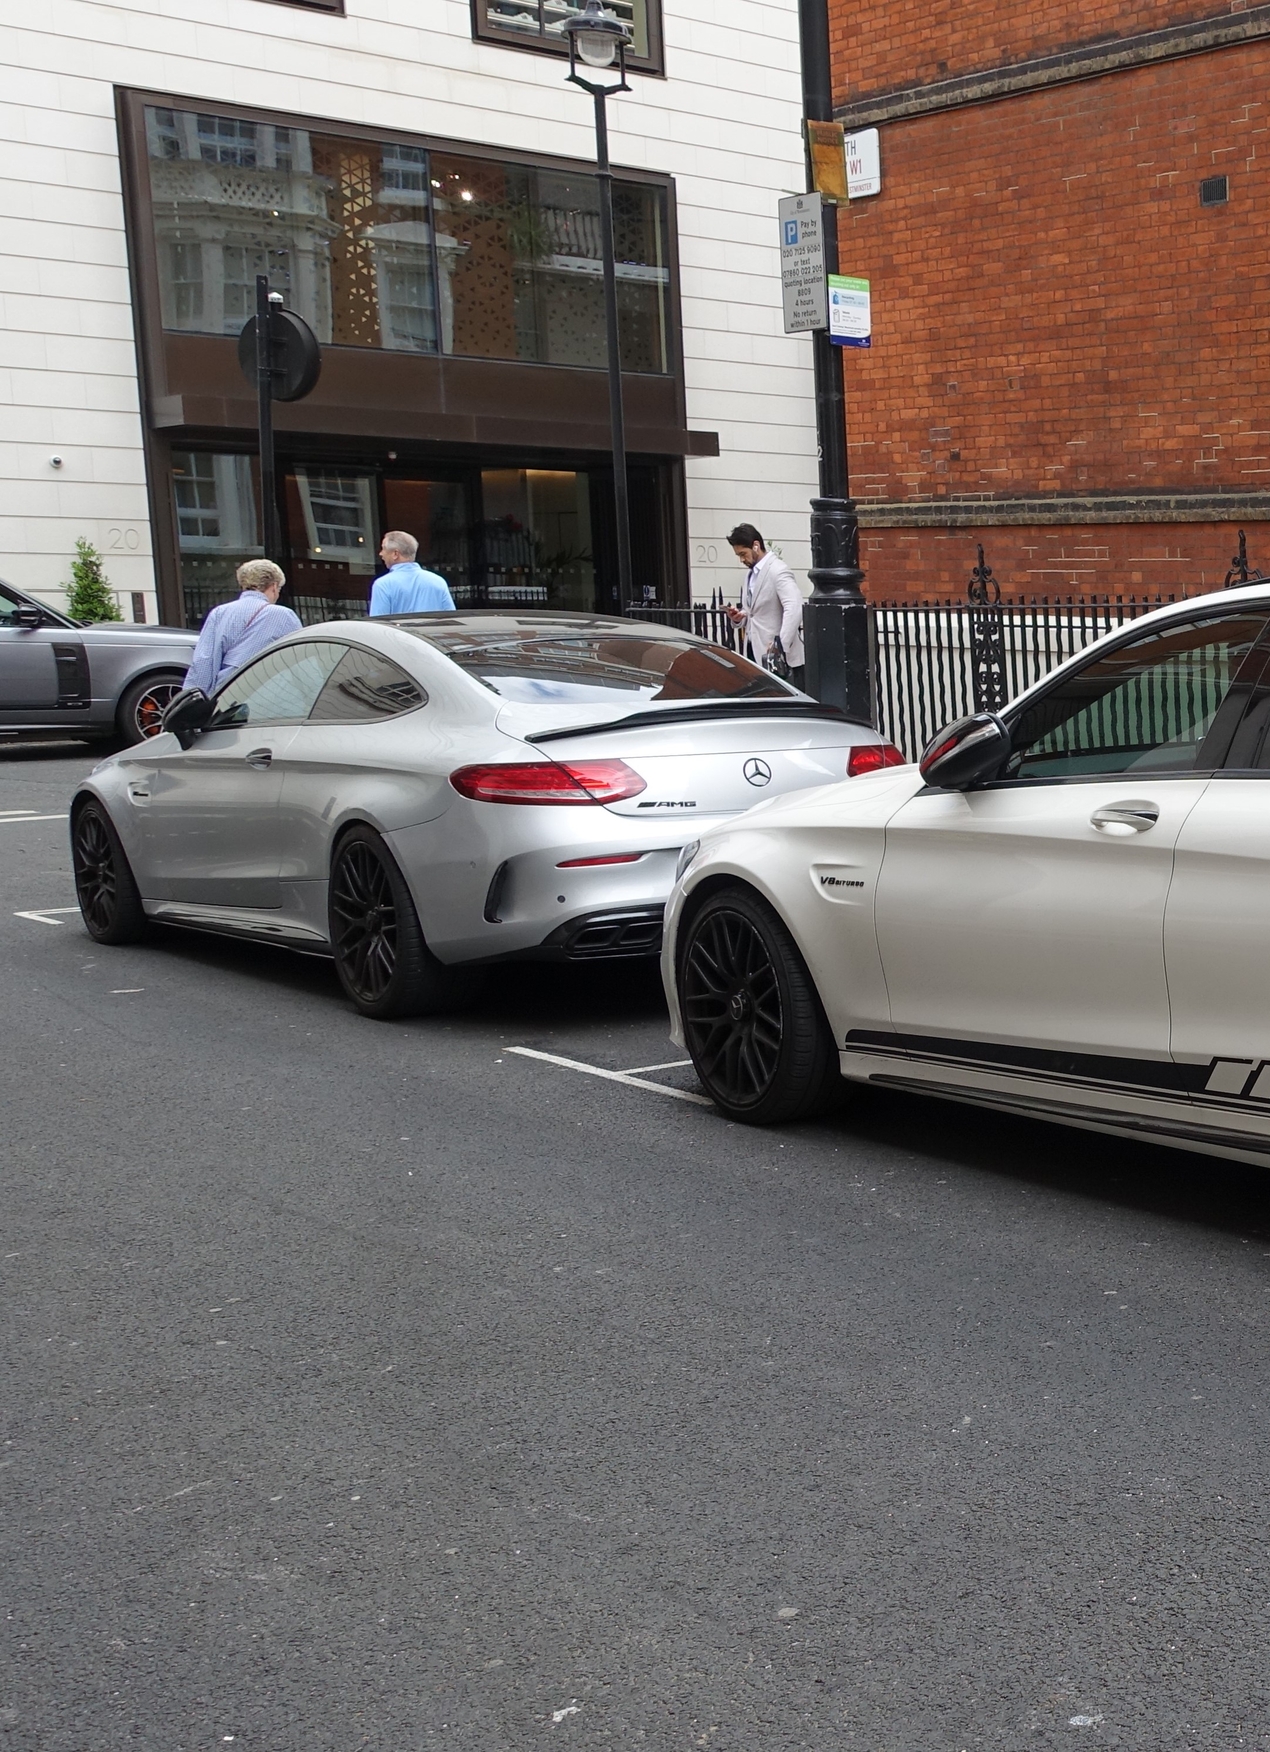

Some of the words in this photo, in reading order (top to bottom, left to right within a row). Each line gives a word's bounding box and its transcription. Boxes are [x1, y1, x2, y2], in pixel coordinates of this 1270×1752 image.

[844, 139, 857, 156] TH
[850, 159, 861, 175] W1
[849, 183, 872, 193] STMINSTER
[801, 220, 809, 229] Pay
[811, 219, 817, 228] by
[802, 230, 817, 239] phone
[801, 257, 811, 266] text
[784, 280, 802, 289] quoting
[803, 276, 823, 284] location
[801, 309, 817, 317] return
[790, 319, 805, 328] within
[810, 318, 821, 326] hour
[108, 528, 140, 550] 20
[696, 545, 718, 563] 20
[656, 800, 697, 808] AMG
